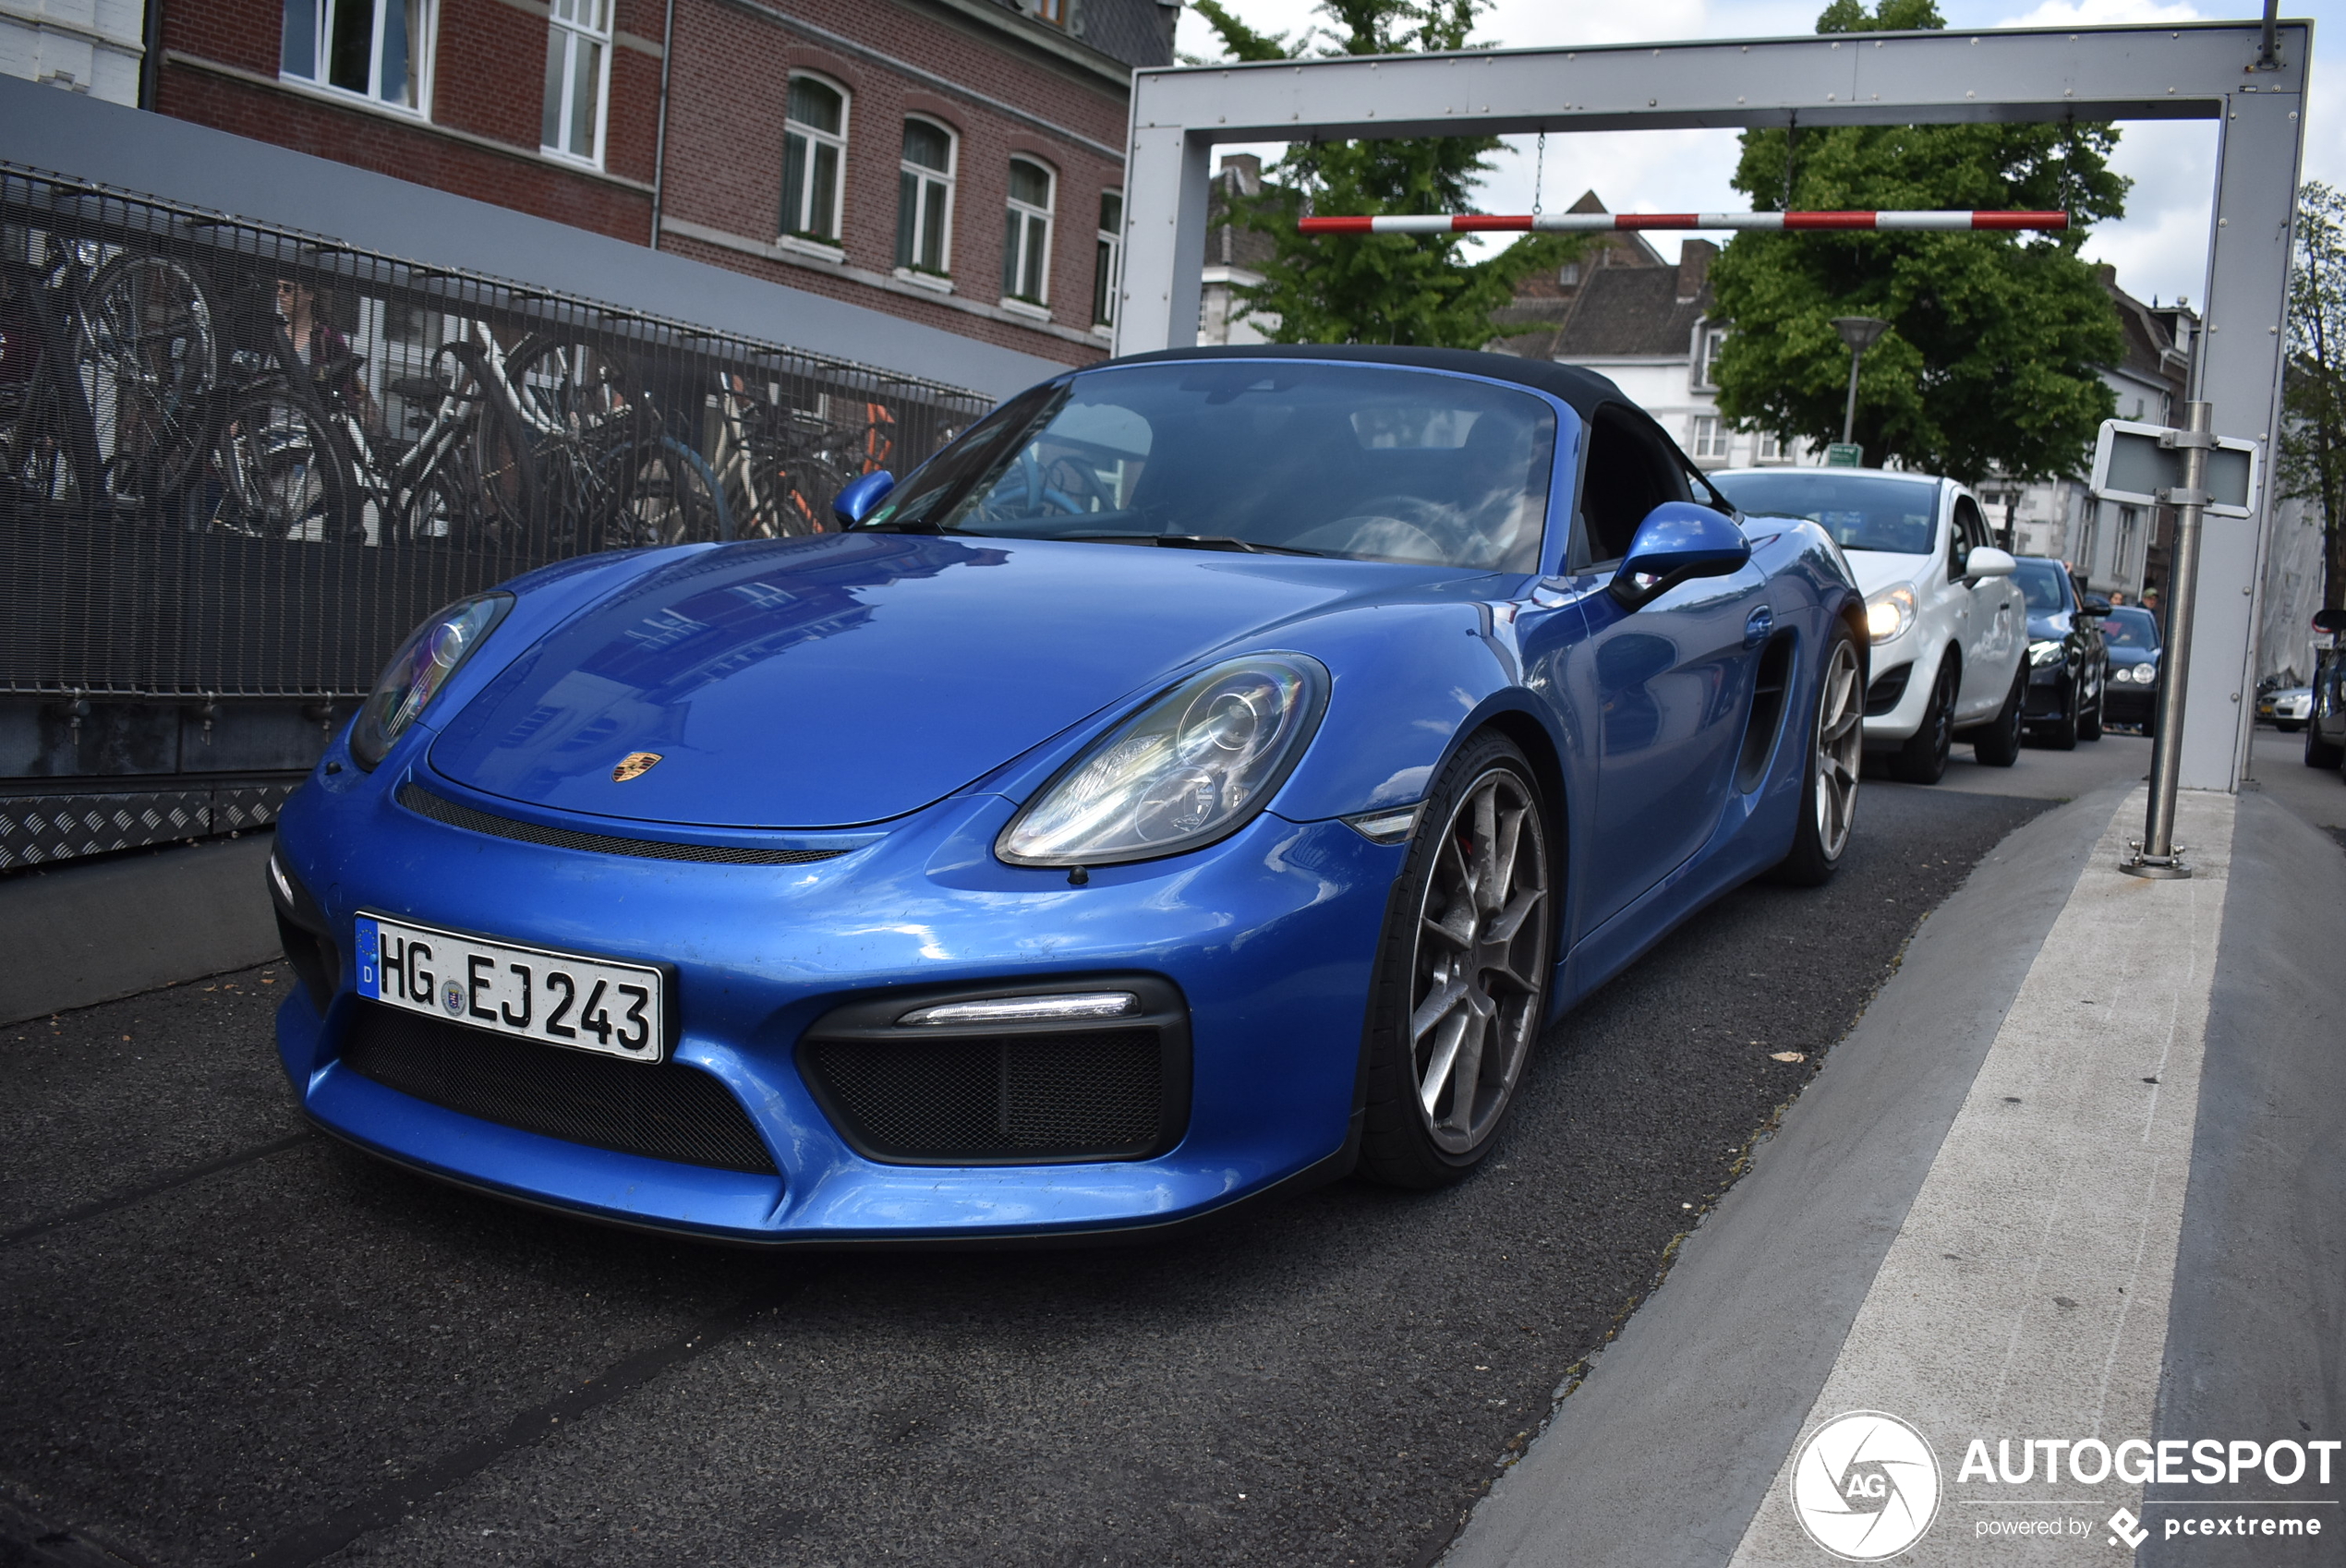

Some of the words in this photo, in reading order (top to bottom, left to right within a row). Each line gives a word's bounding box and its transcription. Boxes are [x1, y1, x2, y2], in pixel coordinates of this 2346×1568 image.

[363, 966, 372, 983] D
[380, 933, 434, 1005] HG
[468, 954, 532, 1028] EJ
[546, 971, 649, 1050] 243
